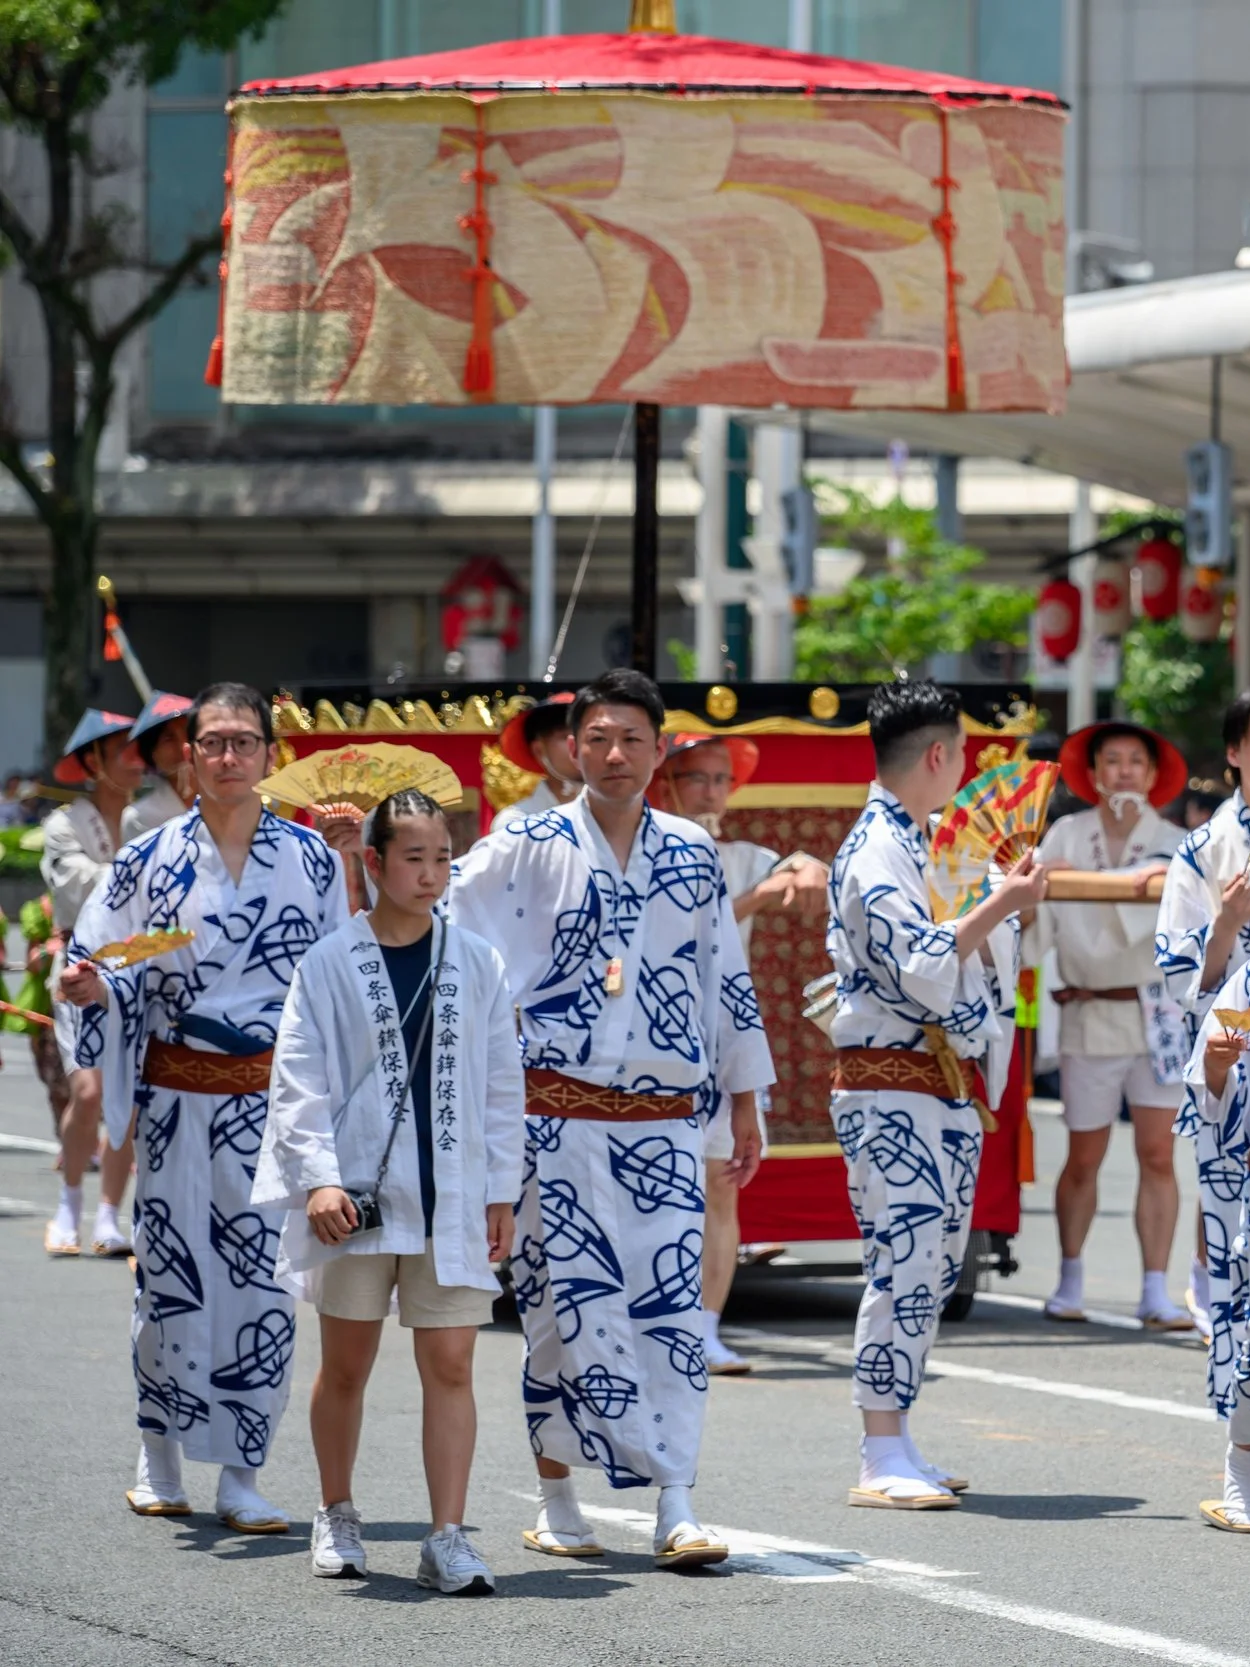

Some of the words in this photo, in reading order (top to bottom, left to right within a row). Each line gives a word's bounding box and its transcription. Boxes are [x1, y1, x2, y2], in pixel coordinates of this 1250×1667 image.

[357, 959, 411, 1124] 四条傘鉾保存会
[434, 981, 460, 1152] 四条傘鉾保存会
